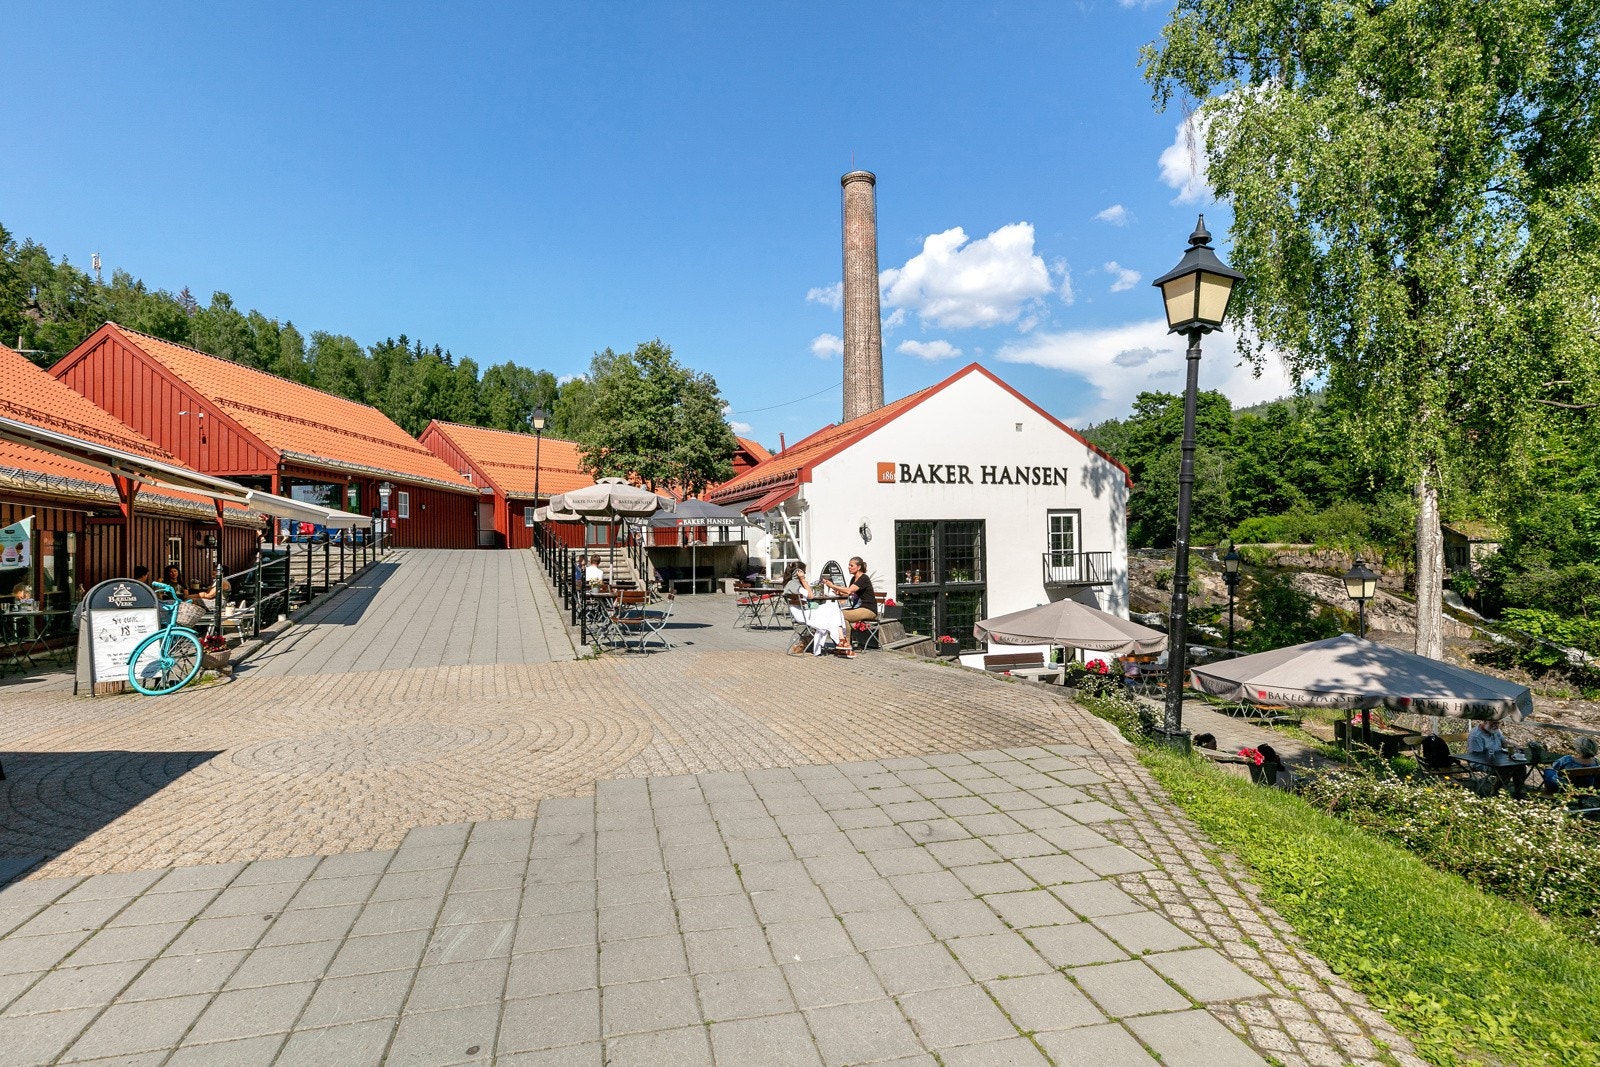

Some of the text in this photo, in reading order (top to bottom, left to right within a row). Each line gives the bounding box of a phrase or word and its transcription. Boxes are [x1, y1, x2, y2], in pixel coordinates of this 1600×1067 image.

[899, 463, 974, 484] BAKER
[980, 465, 1068, 486] HANSEN
[1268, 691, 1364, 703] BAKER HANSEN
[1411, 699, 1501, 715] BAKER HANSEN
